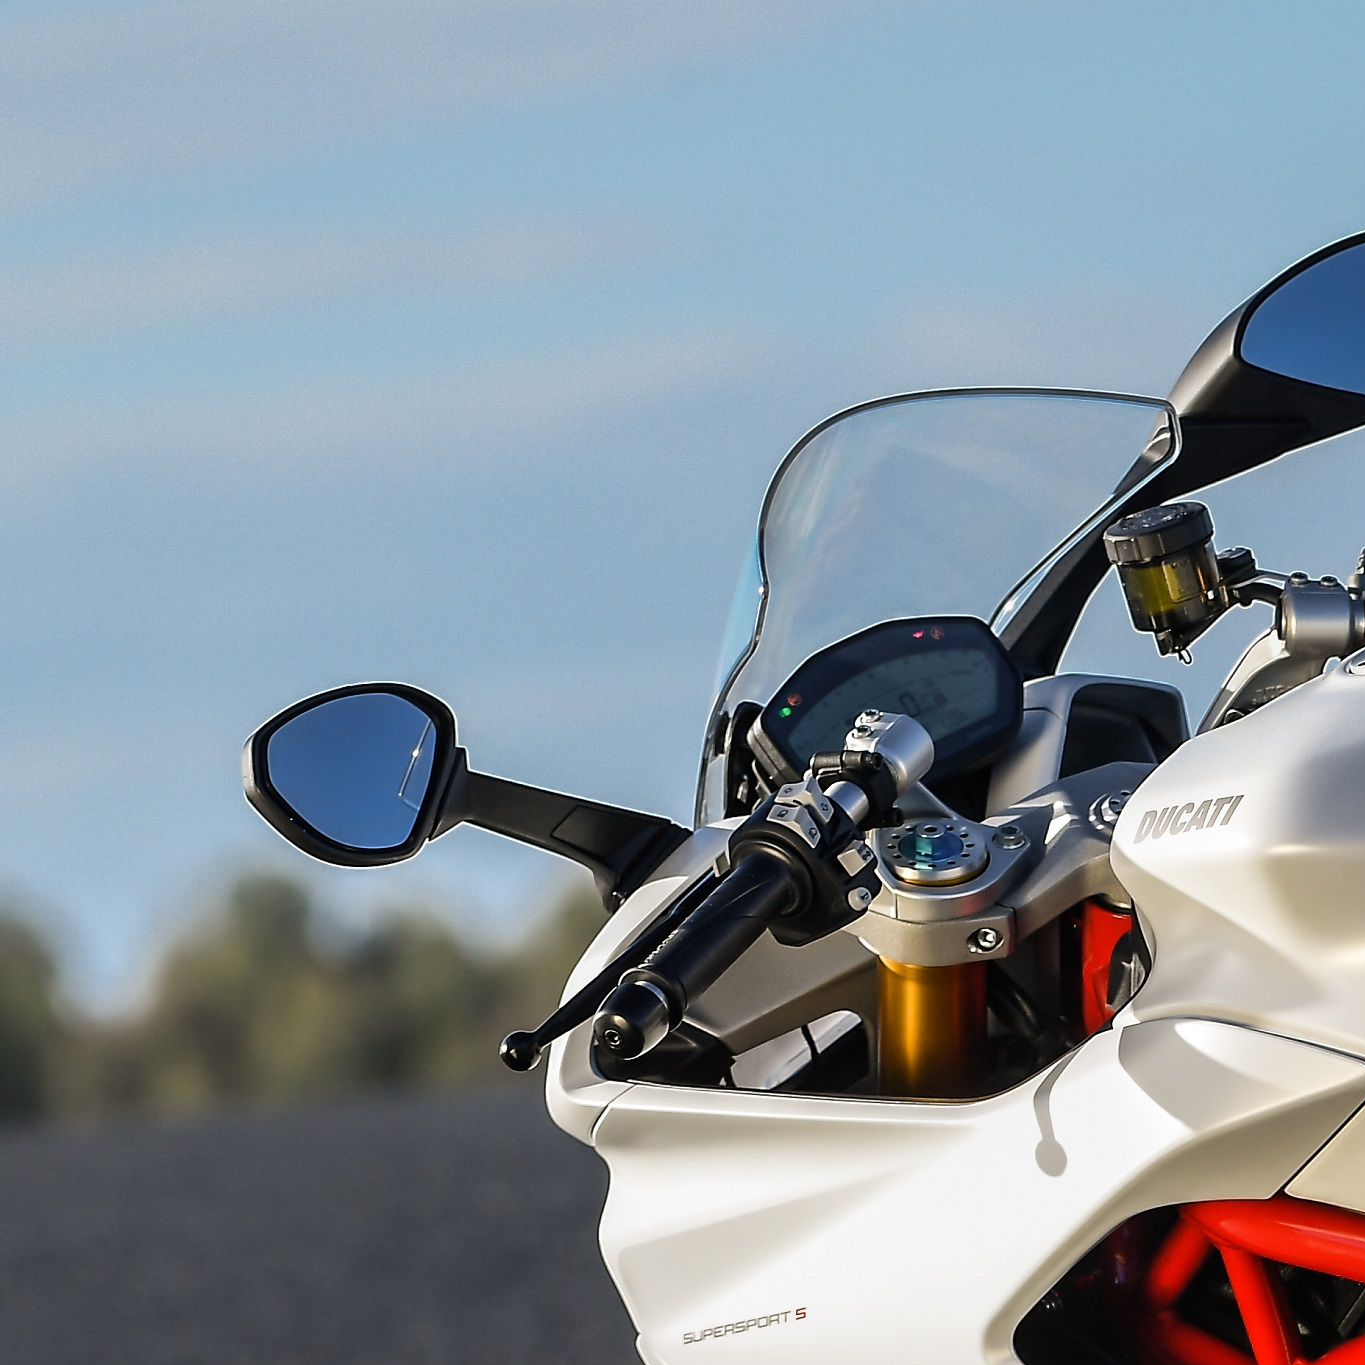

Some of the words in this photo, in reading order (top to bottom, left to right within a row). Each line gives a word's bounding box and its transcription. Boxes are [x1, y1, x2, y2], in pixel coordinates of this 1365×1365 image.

[1133, 794, 1245, 845] DUCATI
[683, 1310, 791, 1345] SUPERSPORT
[795, 1307, 807, 1320] S
